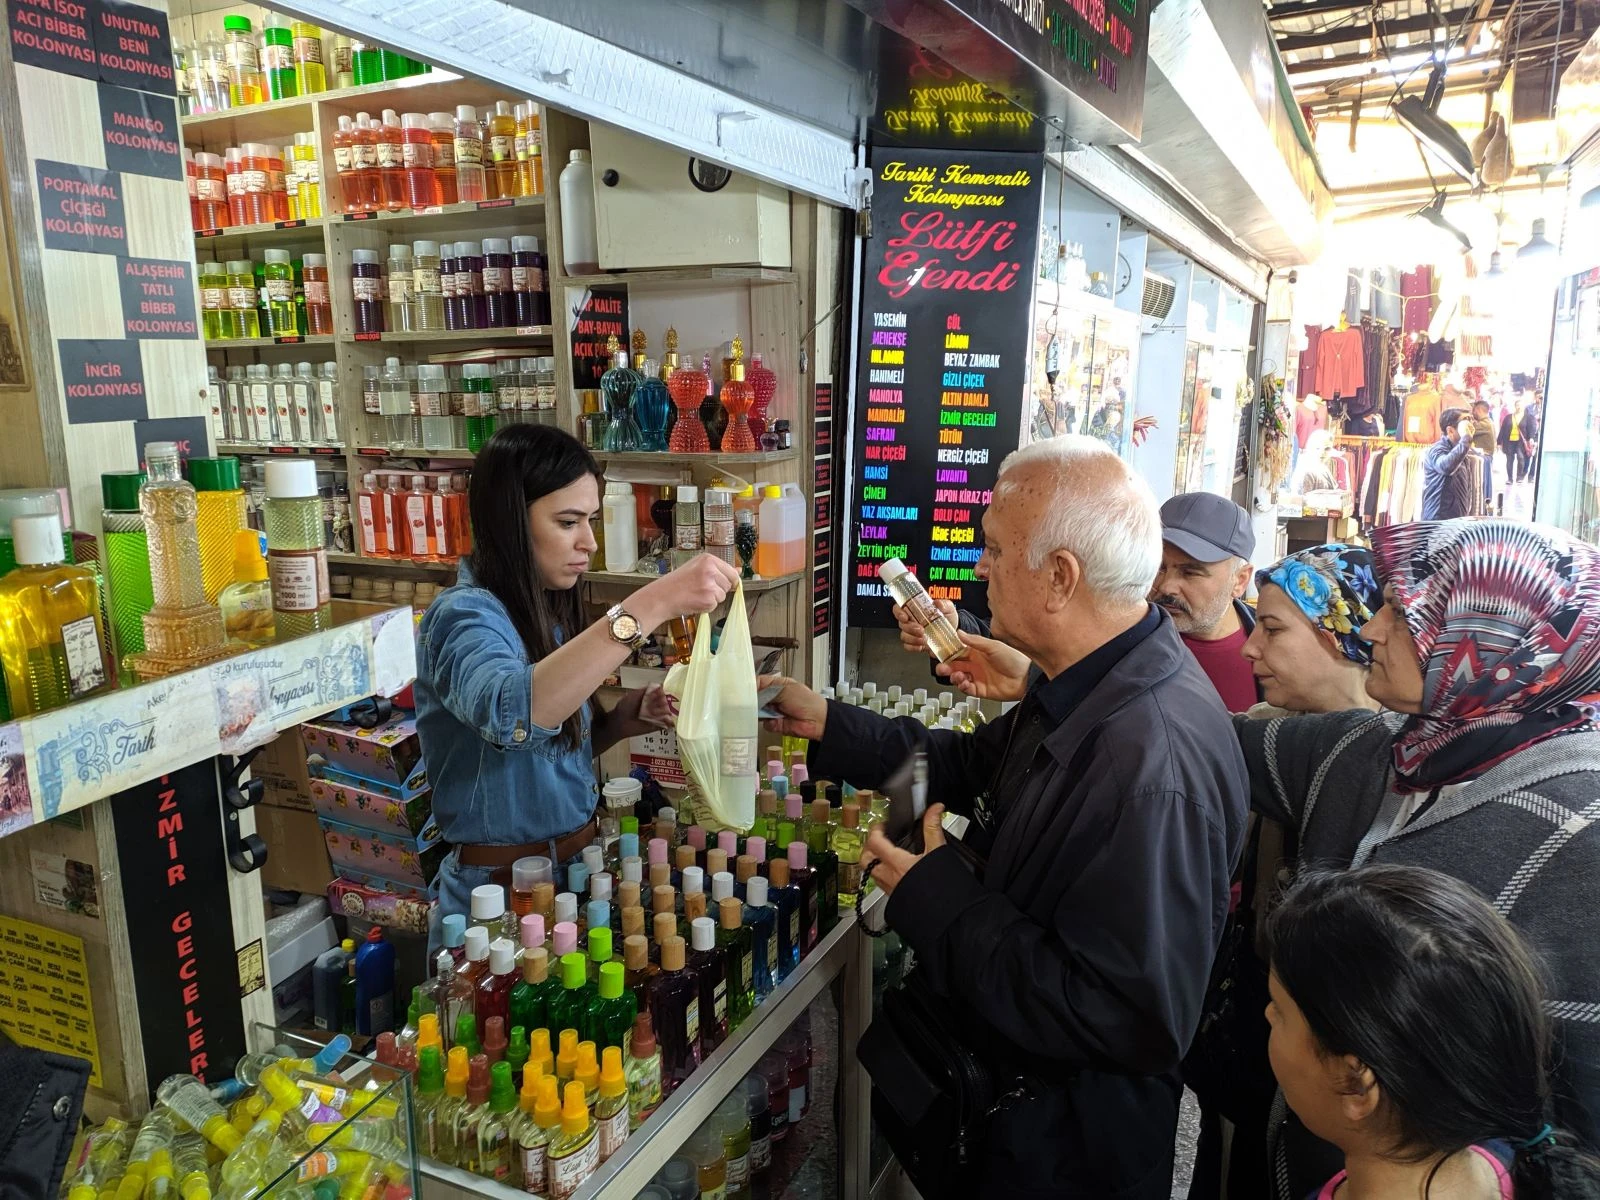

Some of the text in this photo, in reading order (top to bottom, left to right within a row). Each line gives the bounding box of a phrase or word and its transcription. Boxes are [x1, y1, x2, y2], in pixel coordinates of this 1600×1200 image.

[17, 10, 87, 40] ACI BİBER
[102, 13, 160, 39] UNUTMA
[13, 29, 96, 63] KOLONYASI
[119, 36, 149, 56] BENİ
[100, 52, 172, 79] KOLONYASI
[113, 112, 163, 133] MANGO
[106, 130, 178, 155] KOLONYASI
[881, 162, 937, 182] Tarihi
[43, 177, 117, 200] PORTAKAL
[61, 197, 106, 219] ÇİÇEĞİ
[46, 219, 124, 240] KOLONYASI
[888, 211, 1017, 261] Lütfi
[125, 263, 185, 280] ALAŞEHİR
[877, 250, 1021, 298] Efendi
[141, 282, 174, 297] TATLI
[127, 320, 195, 334] KOLONYASI
[874, 312, 907, 328] YASEMİN
[946, 313, 961, 330] GÜL
[872, 331, 907, 348] MENEKŞE
[945, 332, 970, 349] LİMON
[944, 352, 1001, 369] BEYAZ ZAMBAK
[85, 362, 122, 378] İNCİR
[870, 368, 905, 384] HANIMELİ
[942, 371, 985, 389] GİZLİ ÇİÇEK
[67, 383, 142, 398] KOLONYASI
[869, 389, 903, 404] MANOLYA
[941, 391, 989, 408] ALTIN DAMLA
[867, 407, 905, 423] MANDALİN
[940, 409, 997, 427] İZMİR GECELERİ
[866, 427, 896, 442] SAFRAN
[939, 429, 963, 444] TÜTÜN
[865, 445, 906, 463] NAR ÇİÇEĞİ
[937, 448, 989, 465] NERGİZ ÇİÇEĞİ
[864, 465, 889, 480] HAMSİ
[936, 469, 968, 483] LAVANTA
[863, 485, 887, 501] ÇİMEN
[934, 489, 958, 503] JAPON
[959, 488, 981, 504] KİRAZ
[861, 505, 919, 522] YAZ AKŞAMLARI
[933, 508, 970, 524] BOLU ÇAM
[861, 525, 888, 540] LEYLAK
[950, 527, 975, 544] ÇİÇEĞİ
[858, 544, 883, 558] ZEYTİN
[930, 545, 952, 561] İZMİR
[857, 562, 873, 577] DAĞ
[929, 566, 944, 582] ÇAY
[856, 583, 882, 597] DAMLA
[112, 726, 156, 769] Tarih
[171, 910, 208, 1085] GECELER
